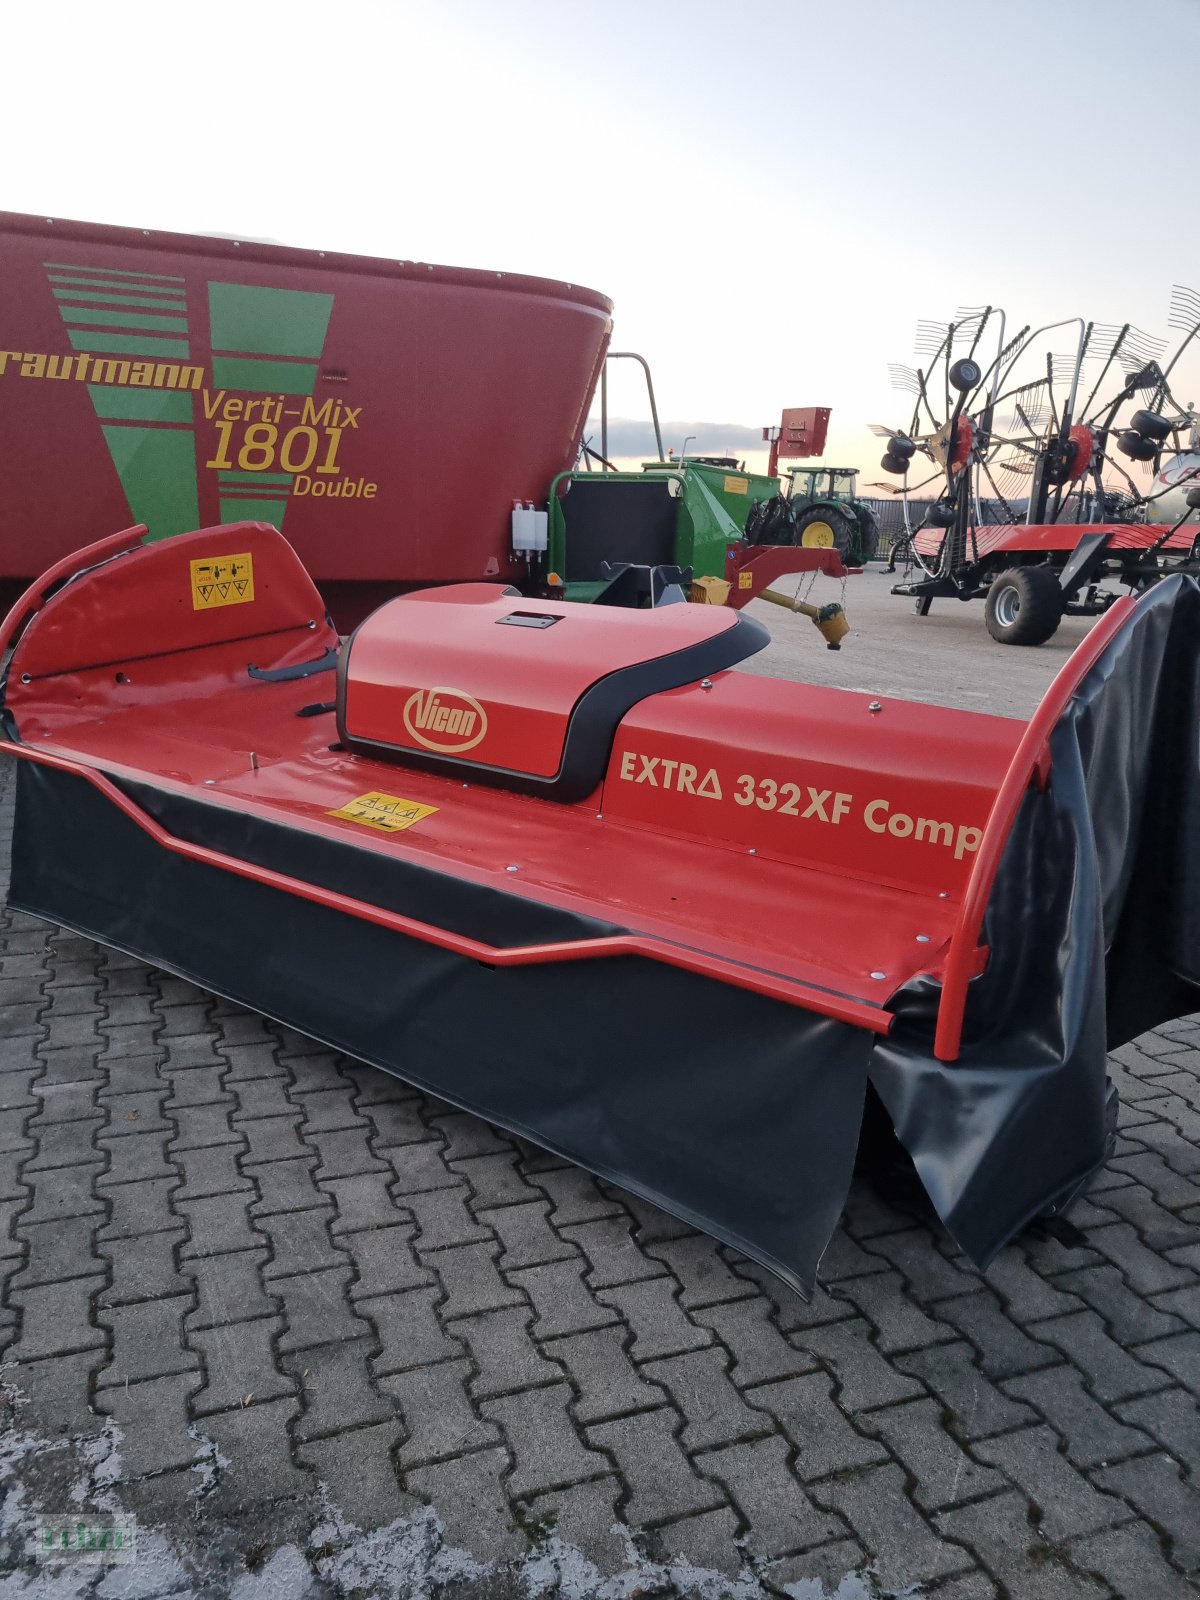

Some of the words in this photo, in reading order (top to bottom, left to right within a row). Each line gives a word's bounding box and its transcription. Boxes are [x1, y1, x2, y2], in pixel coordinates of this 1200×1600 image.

[202, 388, 363, 429] Verti-Mix
[206, 420, 343, 474] 1801
[293, 475, 378, 498] Double
[414, 688, 478, 737] Vicon
[733, 774, 853, 825] 332XF
[863, 799, 984, 861] Comp
